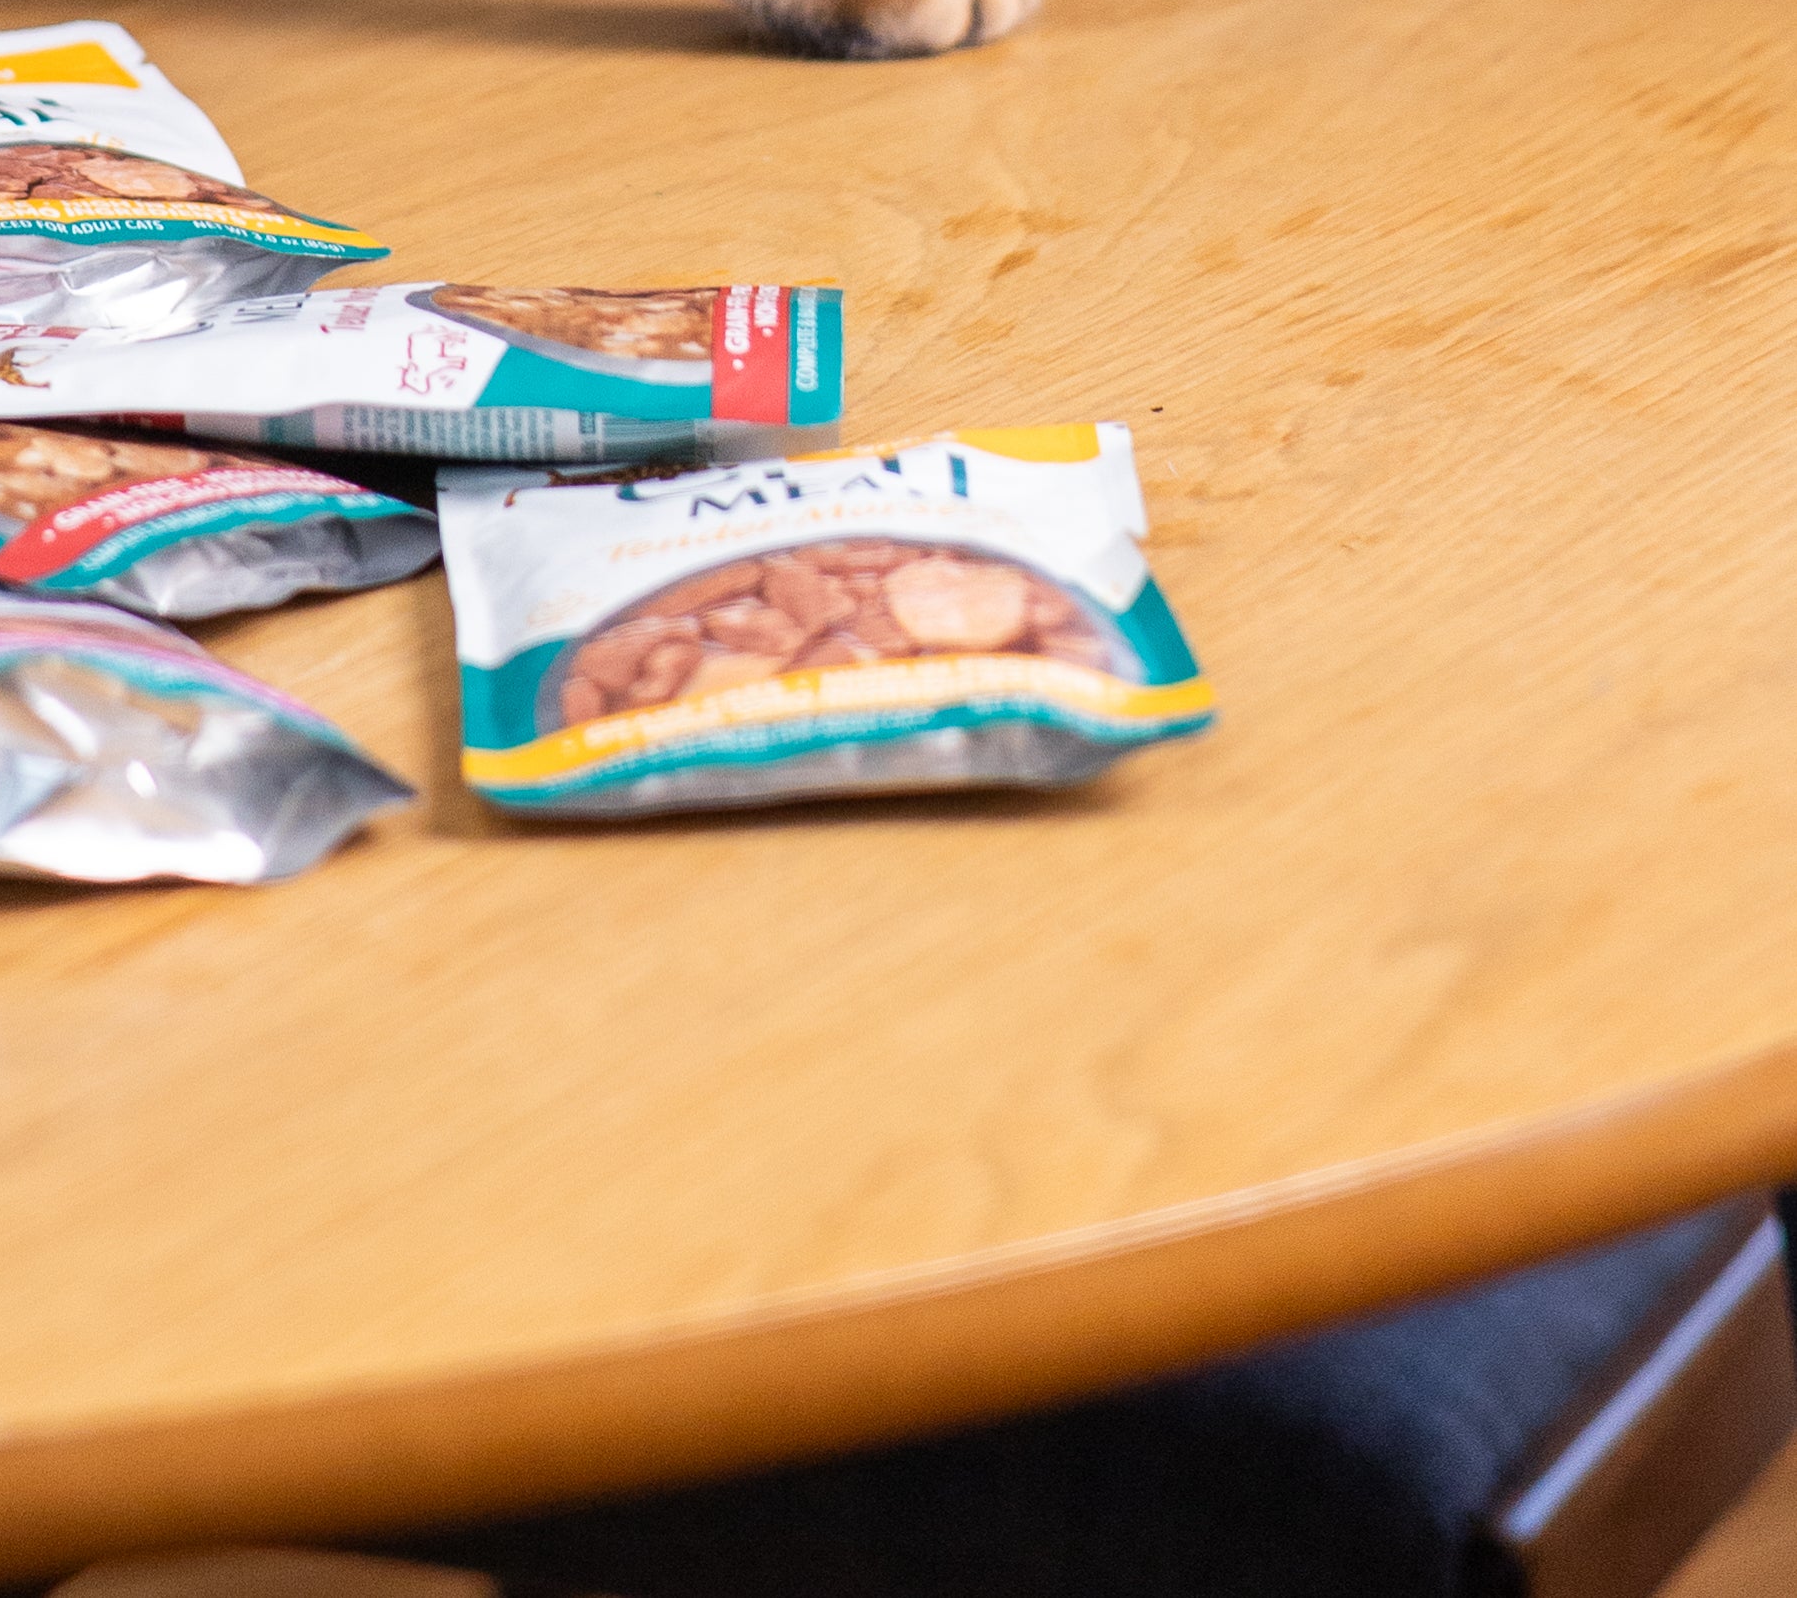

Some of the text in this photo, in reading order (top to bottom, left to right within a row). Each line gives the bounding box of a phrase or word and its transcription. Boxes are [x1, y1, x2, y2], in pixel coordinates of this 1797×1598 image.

[35, 219, 69, 235] FOR
[71, 219, 123, 236] ADULT
[125, 219, 165, 231] CATS
